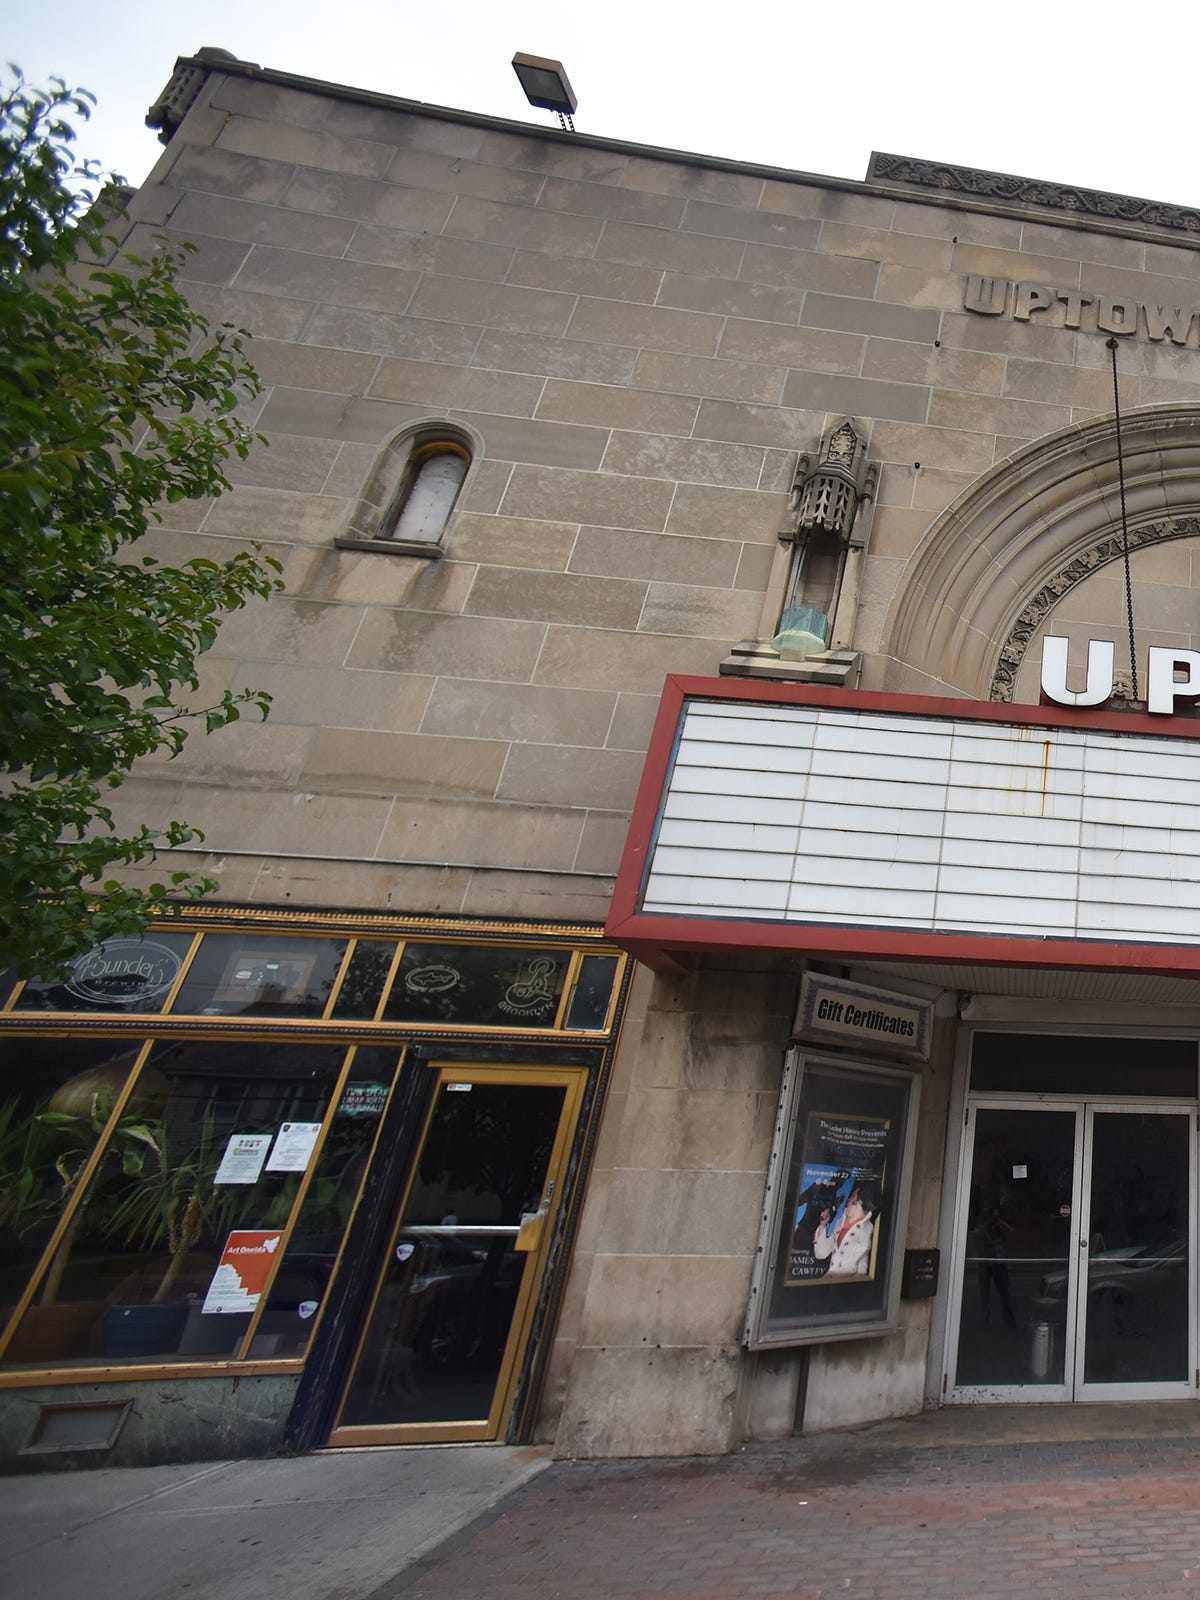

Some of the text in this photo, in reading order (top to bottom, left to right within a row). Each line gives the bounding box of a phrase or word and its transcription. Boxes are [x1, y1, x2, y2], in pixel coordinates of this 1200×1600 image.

[497, 1001, 555, 1017] BROOKLYN
[817, 998, 915, 1037] Gift Certificates
[861, 1129, 887, 1137] Presents
[806, 1168, 840, 1178] November
[240, 1246, 266, 1254] Oneida
